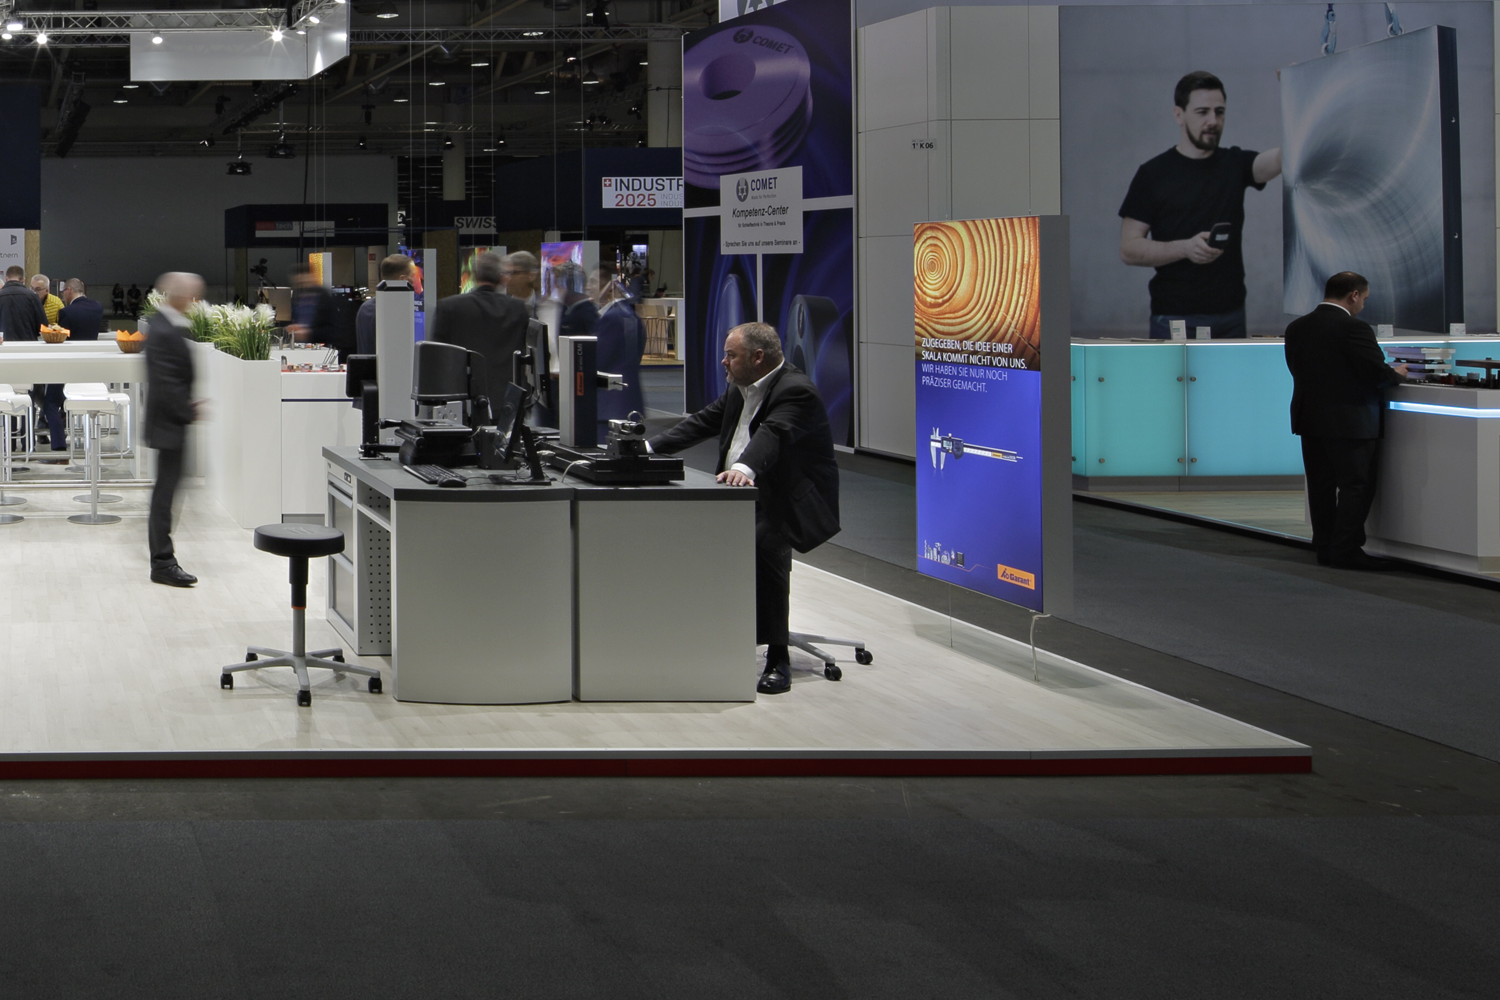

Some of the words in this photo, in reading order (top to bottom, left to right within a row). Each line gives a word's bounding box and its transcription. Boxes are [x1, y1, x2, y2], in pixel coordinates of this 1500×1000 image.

[752, 36, 794, 54] COMET
[750, 176, 778, 191] COMET
[615, 193, 657, 207] 2025
[732, 205, 789, 219] Kompetenz-Center
[921, 338, 961, 351] ZUGEGEBEN,
[962, 340, 974, 351] DIE
[975, 341, 991, 352] IDEE
[992, 342, 1013, 353] EINER
[921, 350, 941, 361] SKALA
[942, 352, 968, 363] KOMMT
[969, 354, 991, 365] NICHT
[991, 356, 1009, 367] VON
[1009, 357, 1027, 369] UNS.
[921, 363, 934, 373] WIR
[935, 364, 957, 376] HABEN
[958, 366, 969, 377] SIE
[969, 367, 985, 378] NUR
[986, 368, 1008, 381] NOCH
[921, 375, 952, 388] PRÄZISER
[952, 379, 988, 393] GEMACHT.
[1009, 573, 1030, 586] Garant
